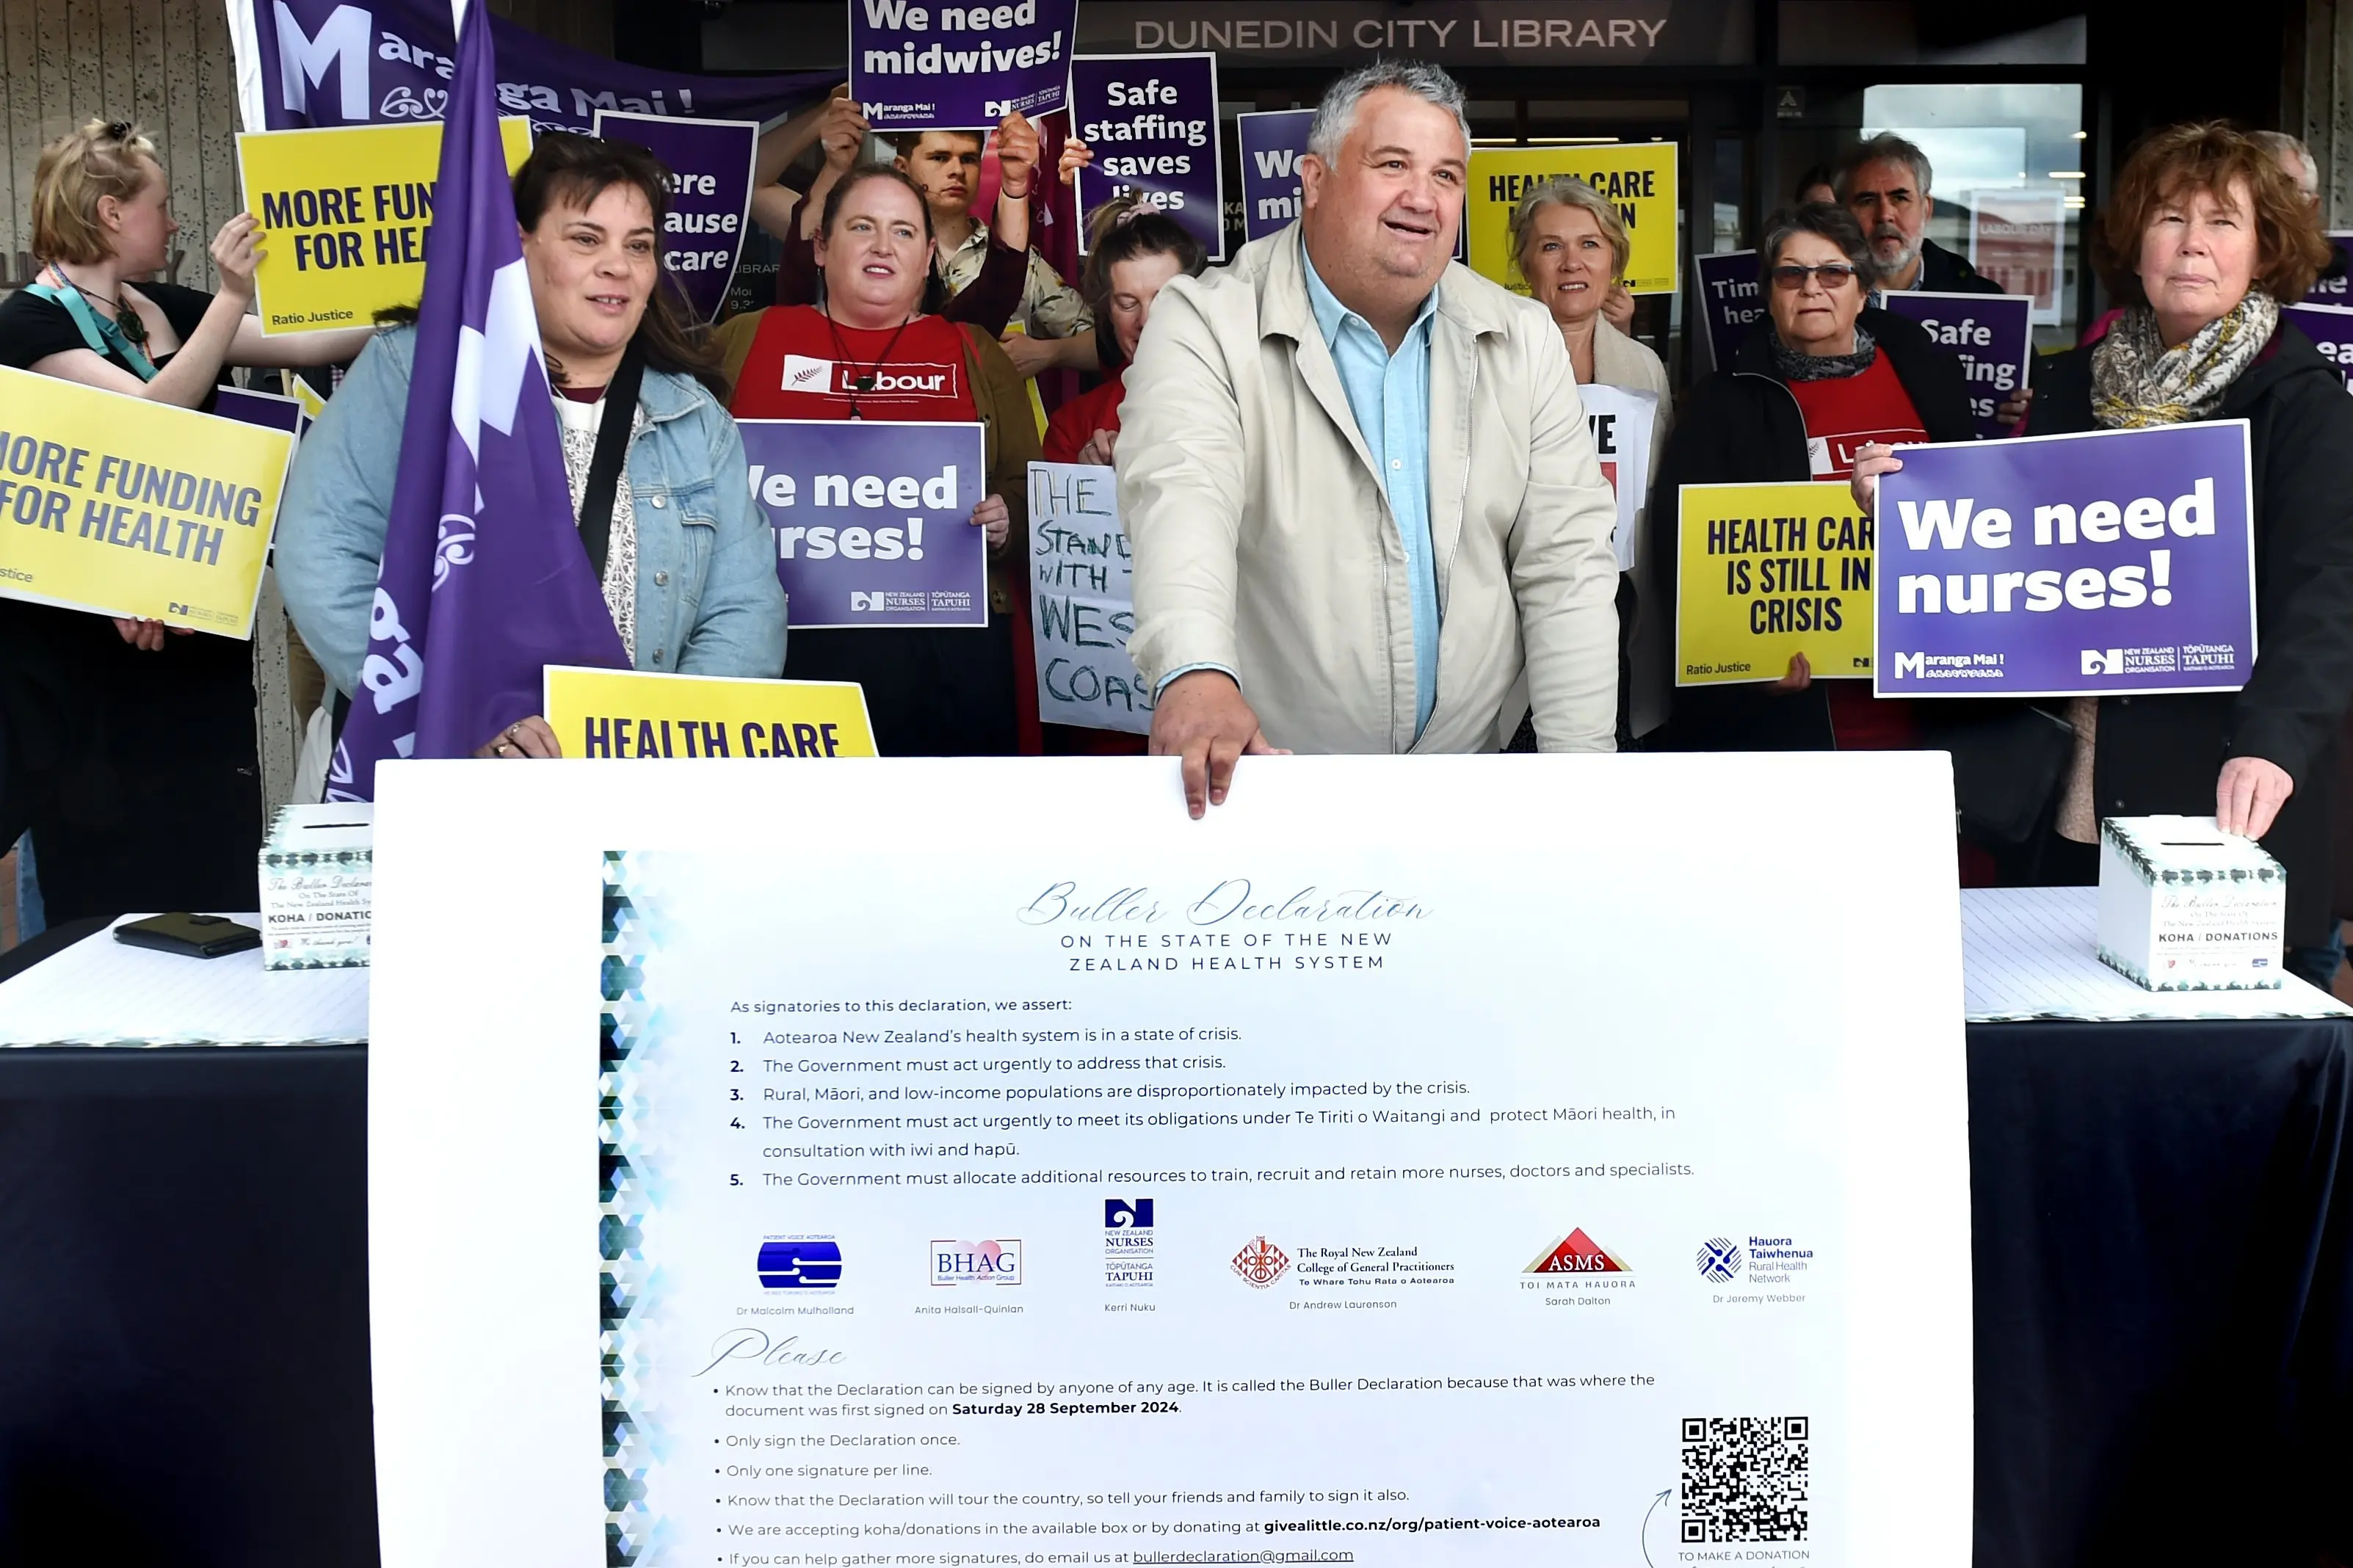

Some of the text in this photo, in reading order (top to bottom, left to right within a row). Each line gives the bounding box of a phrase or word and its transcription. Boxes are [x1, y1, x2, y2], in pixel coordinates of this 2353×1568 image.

[863, 0, 1035, 31] We need
[1135, 19, 1667, 49] DUNEDIN CITY LIBRARY
[864, 30, 1062, 74] midwives!
[1107, 79, 1178, 106] Safe
[1084, 114, 1206, 147] staffing
[1103, 153, 1191, 176] saves
[1589, 170, 1656, 198] CARE
[262, 186, 365, 229] MORE
[294, 231, 365, 271] FOR
[663, 250, 729, 272] care
[1711, 278, 1758, 299] Tim
[272, 309, 353, 325] Ratio Justice
[842, 370, 945, 391] Lbour
[95, 454, 261, 527] FUNDING
[814, 465, 957, 509] need
[1030, 468, 1112, 518] THE
[1897, 476, 2216, 551] We need
[0, 480, 223, 566] FOR HEALTH
[1708, 516, 1874, 555] HEALTH CAR
[1039, 559, 1108, 593] WITH
[1727, 556, 1870, 595] IS STILL IN
[1898, 549, 2173, 614] nurses!
[885, 598, 925, 606] NURSES
[931, 598, 971, 606] TAPUHI
[1039, 595, 1134, 648] WES
[1750, 597, 1843, 634] CRISIS
[1973, 653, 1996, 666] Mai
[2142, 647, 2174, 655] ZEALAND
[2182, 654, 2234, 665] TAPUHI
[1686, 661, 1751, 675] Ratio Justice
[2125, 655, 2175, 666] NURSES
[2125, 666, 2175, 674] ORGANISATION
[1045, 658, 1156, 711] COAS
[1016, 879, 1435, 926] Buller Declaration
[268, 913, 305, 923] KOHA
[316, 911, 371, 921] DONATIO
[1060, 932, 1391, 948] ON THE STATE OF THE NEW
[2158, 933, 2194, 943] KOHA
[2205, 932, 2278, 941] DONATIONS
[1069, 955, 1382, 973] ZEALAND HEALTH SYSTEM
[729, 998, 1073, 1016] As signatories to this declaration, we assert:
[729, 1080, 1470, 1103] 3. Rural, Māori, and low-income populations are disproportionately impacted by the crisis.
[1106, 1238, 1153, 1246] NURSES
[1748, 1235, 1793, 1250] Hauora
[936, 1252, 1015, 1272] BHAG
[1296, 1245, 1418, 1262] The Royal New Zealand
[1548, 1254, 1605, 1271] ASMS
[1747, 1247, 1813, 1261] Taiwhenua
[1106, 1272, 1153, 1281] TAPUHI
[1297, 1259, 1454, 1276] College of General Practitioners
[1749, 1260, 1808, 1275] Rural Health
[1519, 1280, 1636, 1290] TOI MATA HAUORA
[1749, 1272, 1791, 1284] Network
[914, 1303, 1024, 1315] Anita Halsall-Quinlan
[1104, 1302, 1156, 1313] Kerri Nuku
[1545, 1296, 1611, 1306] Sarah Dalton
[736, 1306, 855, 1315] Dr Malcolm Mulholland
[691, 1327, 846, 1378] Please
[725, 1431, 961, 1450] Only sign the Declaration once.
[1677, 1550, 1810, 1563] TO MAKE A DONATION
